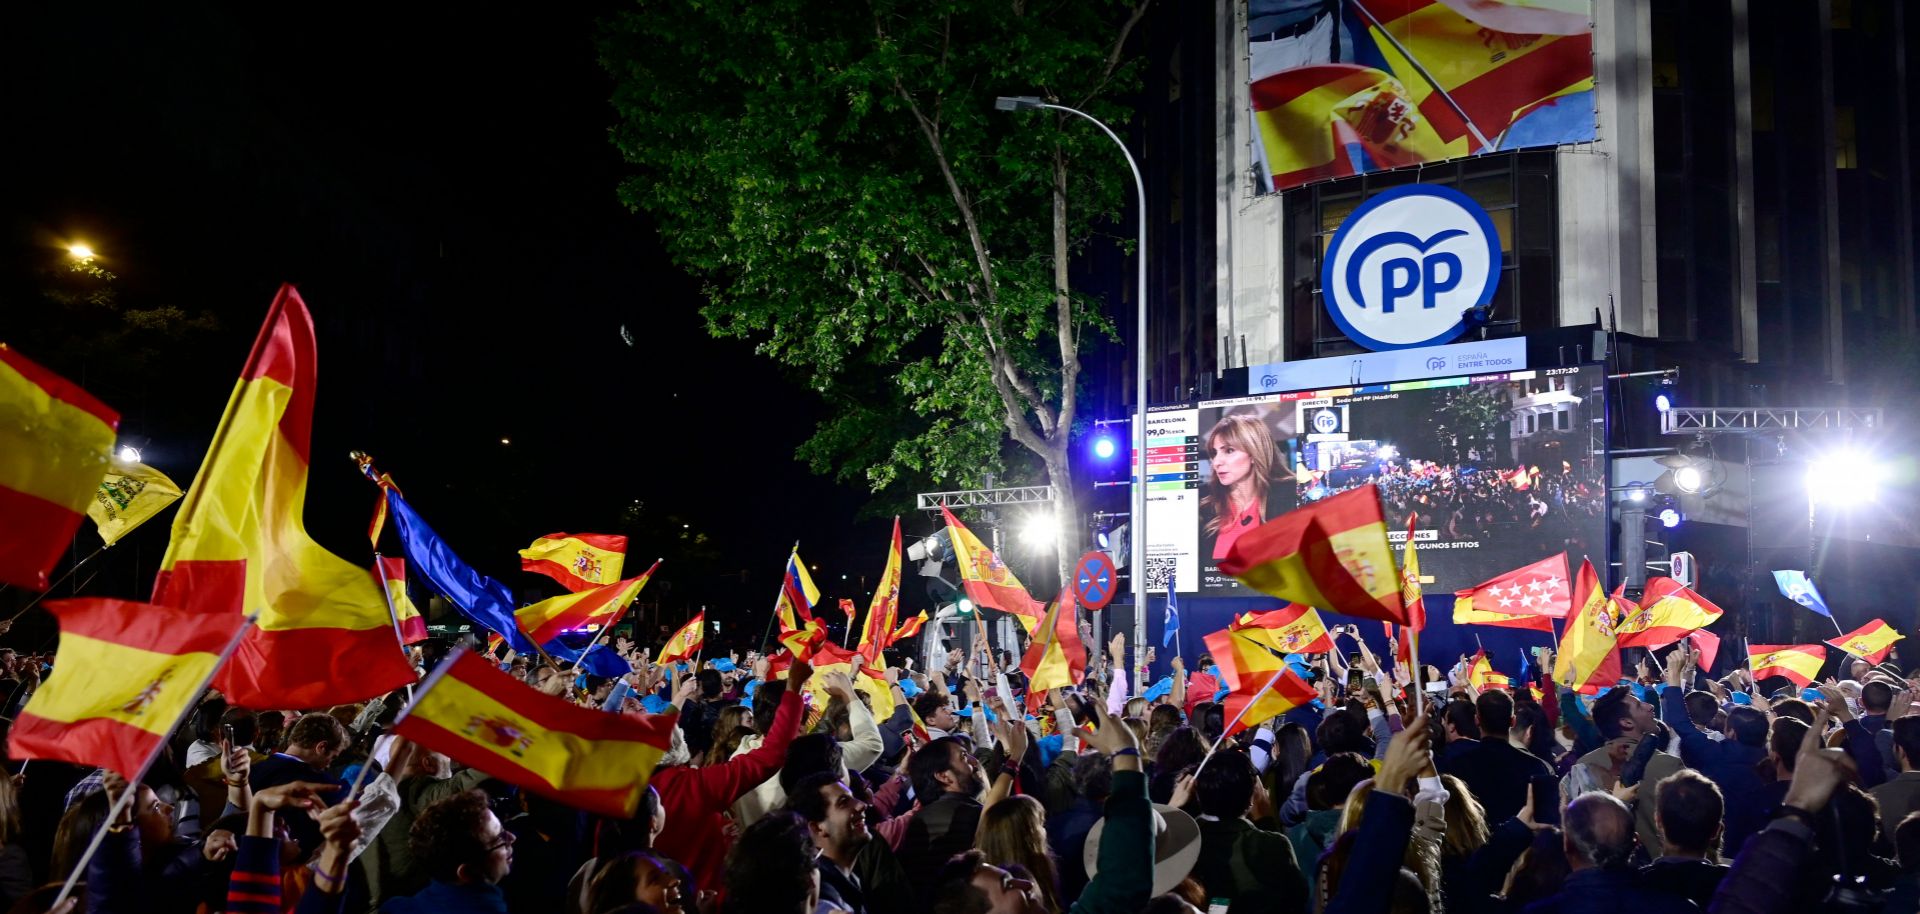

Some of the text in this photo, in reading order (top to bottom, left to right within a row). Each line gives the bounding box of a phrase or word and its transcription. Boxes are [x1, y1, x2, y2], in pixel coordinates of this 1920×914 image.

[1457, 352, 1488, 362] ESPAÑA
[1458, 358, 1512, 369] ENTRE TODOS
[1546, 367, 1579, 376] 23:17:20
[1148, 417, 1186, 425] BARCELONA
[1414, 542, 1450, 550] LGUNOS
